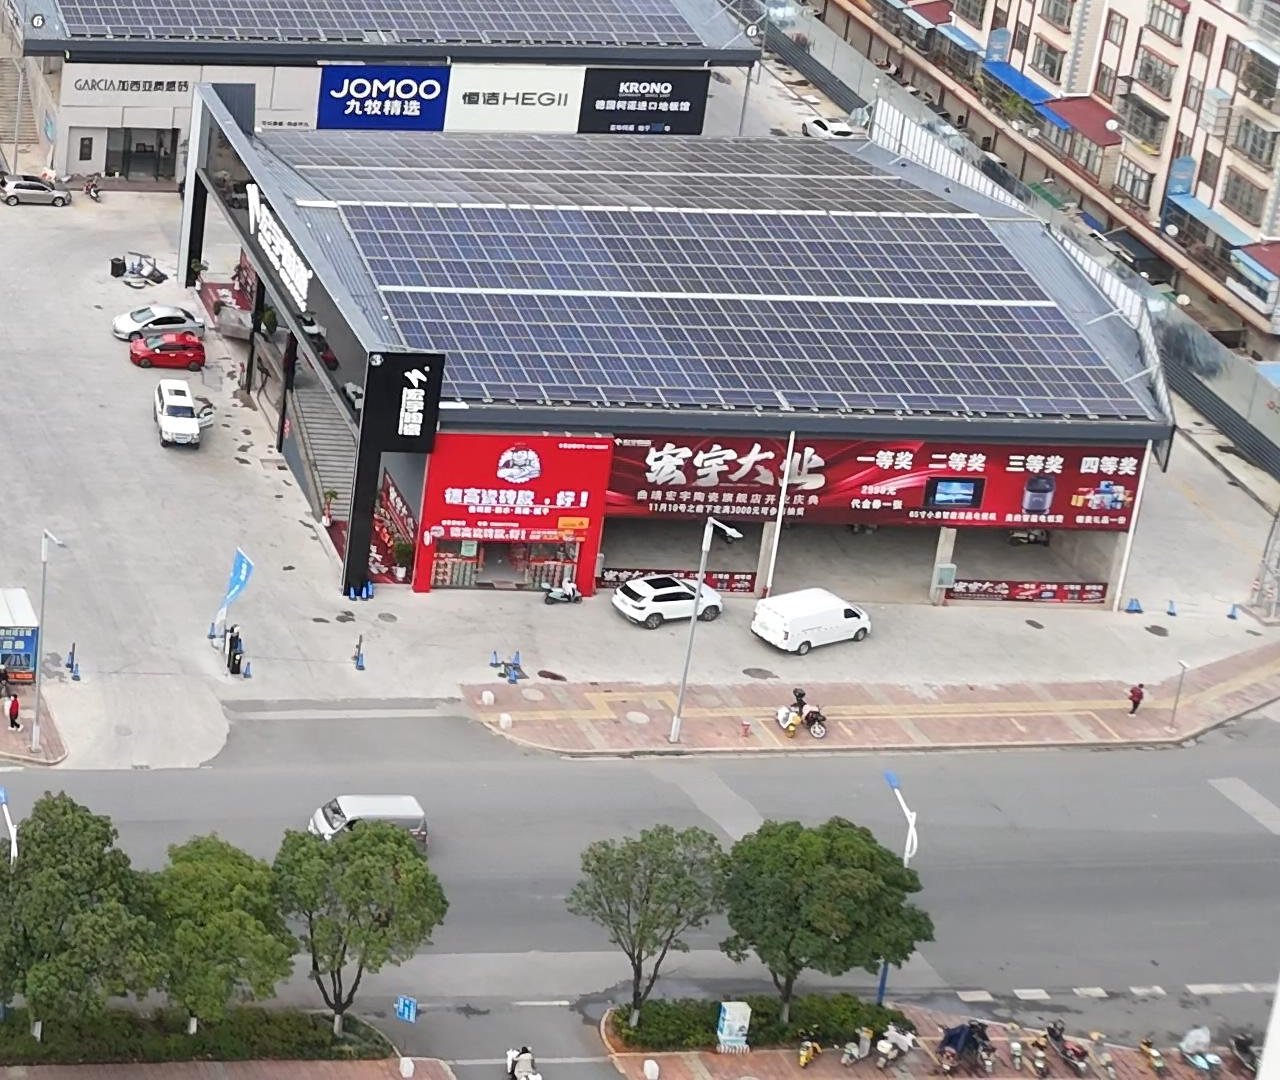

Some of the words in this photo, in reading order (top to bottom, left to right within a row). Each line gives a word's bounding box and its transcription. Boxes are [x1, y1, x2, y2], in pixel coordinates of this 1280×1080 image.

[33, 16, 43, 27] 6
[747, 25, 757, 37] 6
[74, 79, 116, 91] GARCIA
[330, 78, 441, 100] JOMOO
[618, 82, 673, 94] KRONO
[462, 92, 500, 106] 恒洁
[502, 92, 569, 107] HEGII
[344, 99, 421, 116] 九牧精选
[644, 442, 826, 491] 宏宇大业
[857, 450, 914, 470] 一等奖
[928, 452, 987, 472] 二等奖
[1005, 455, 1065, 474] 三等奖
[1079, 456, 1138, 475] 四等奖
